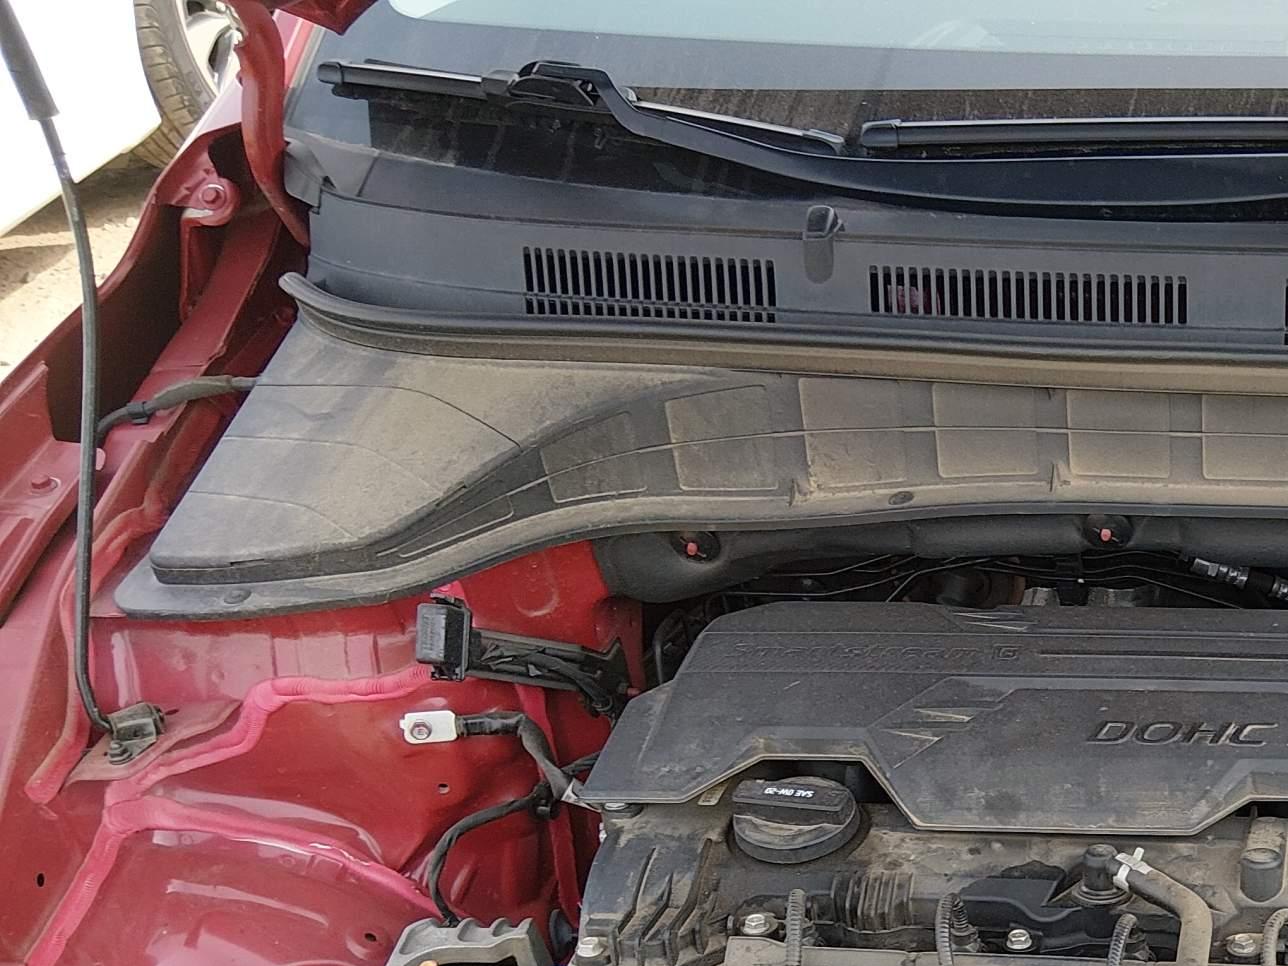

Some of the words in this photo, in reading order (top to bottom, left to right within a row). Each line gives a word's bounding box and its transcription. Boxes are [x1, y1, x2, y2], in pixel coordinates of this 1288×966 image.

[1087, 720, 1279, 745] DOHC
[763, 786, 794, 797] 0W-20
[794, 788, 816, 799] SAE
